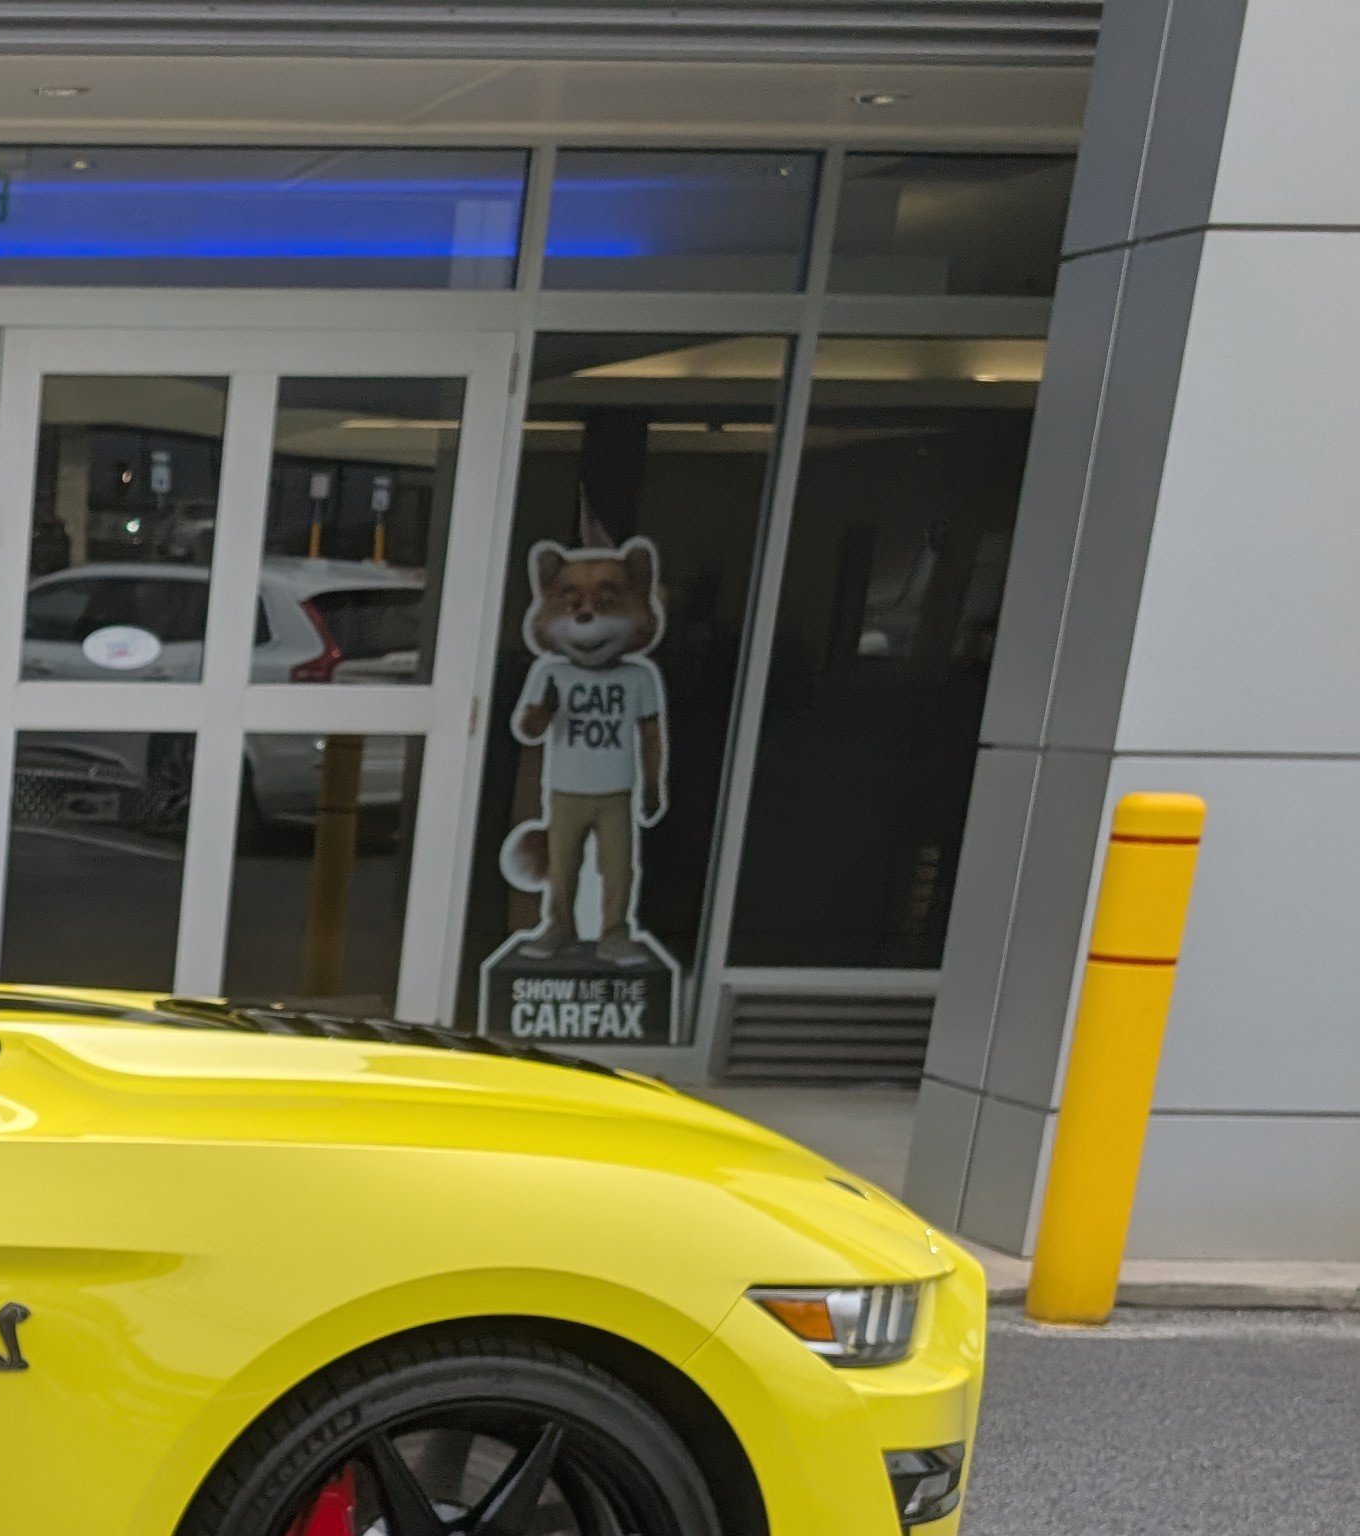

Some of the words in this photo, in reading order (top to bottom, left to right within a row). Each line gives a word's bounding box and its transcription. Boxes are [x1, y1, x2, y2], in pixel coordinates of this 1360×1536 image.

[568, 684, 625, 715] CAR
[568, 719, 621, 749] FOX
[512, 978, 575, 1001] SHOW
[578, 979, 608, 1001] ME
[612, 979, 646, 1001] THE
[511, 1002, 647, 1038] CARFAX
